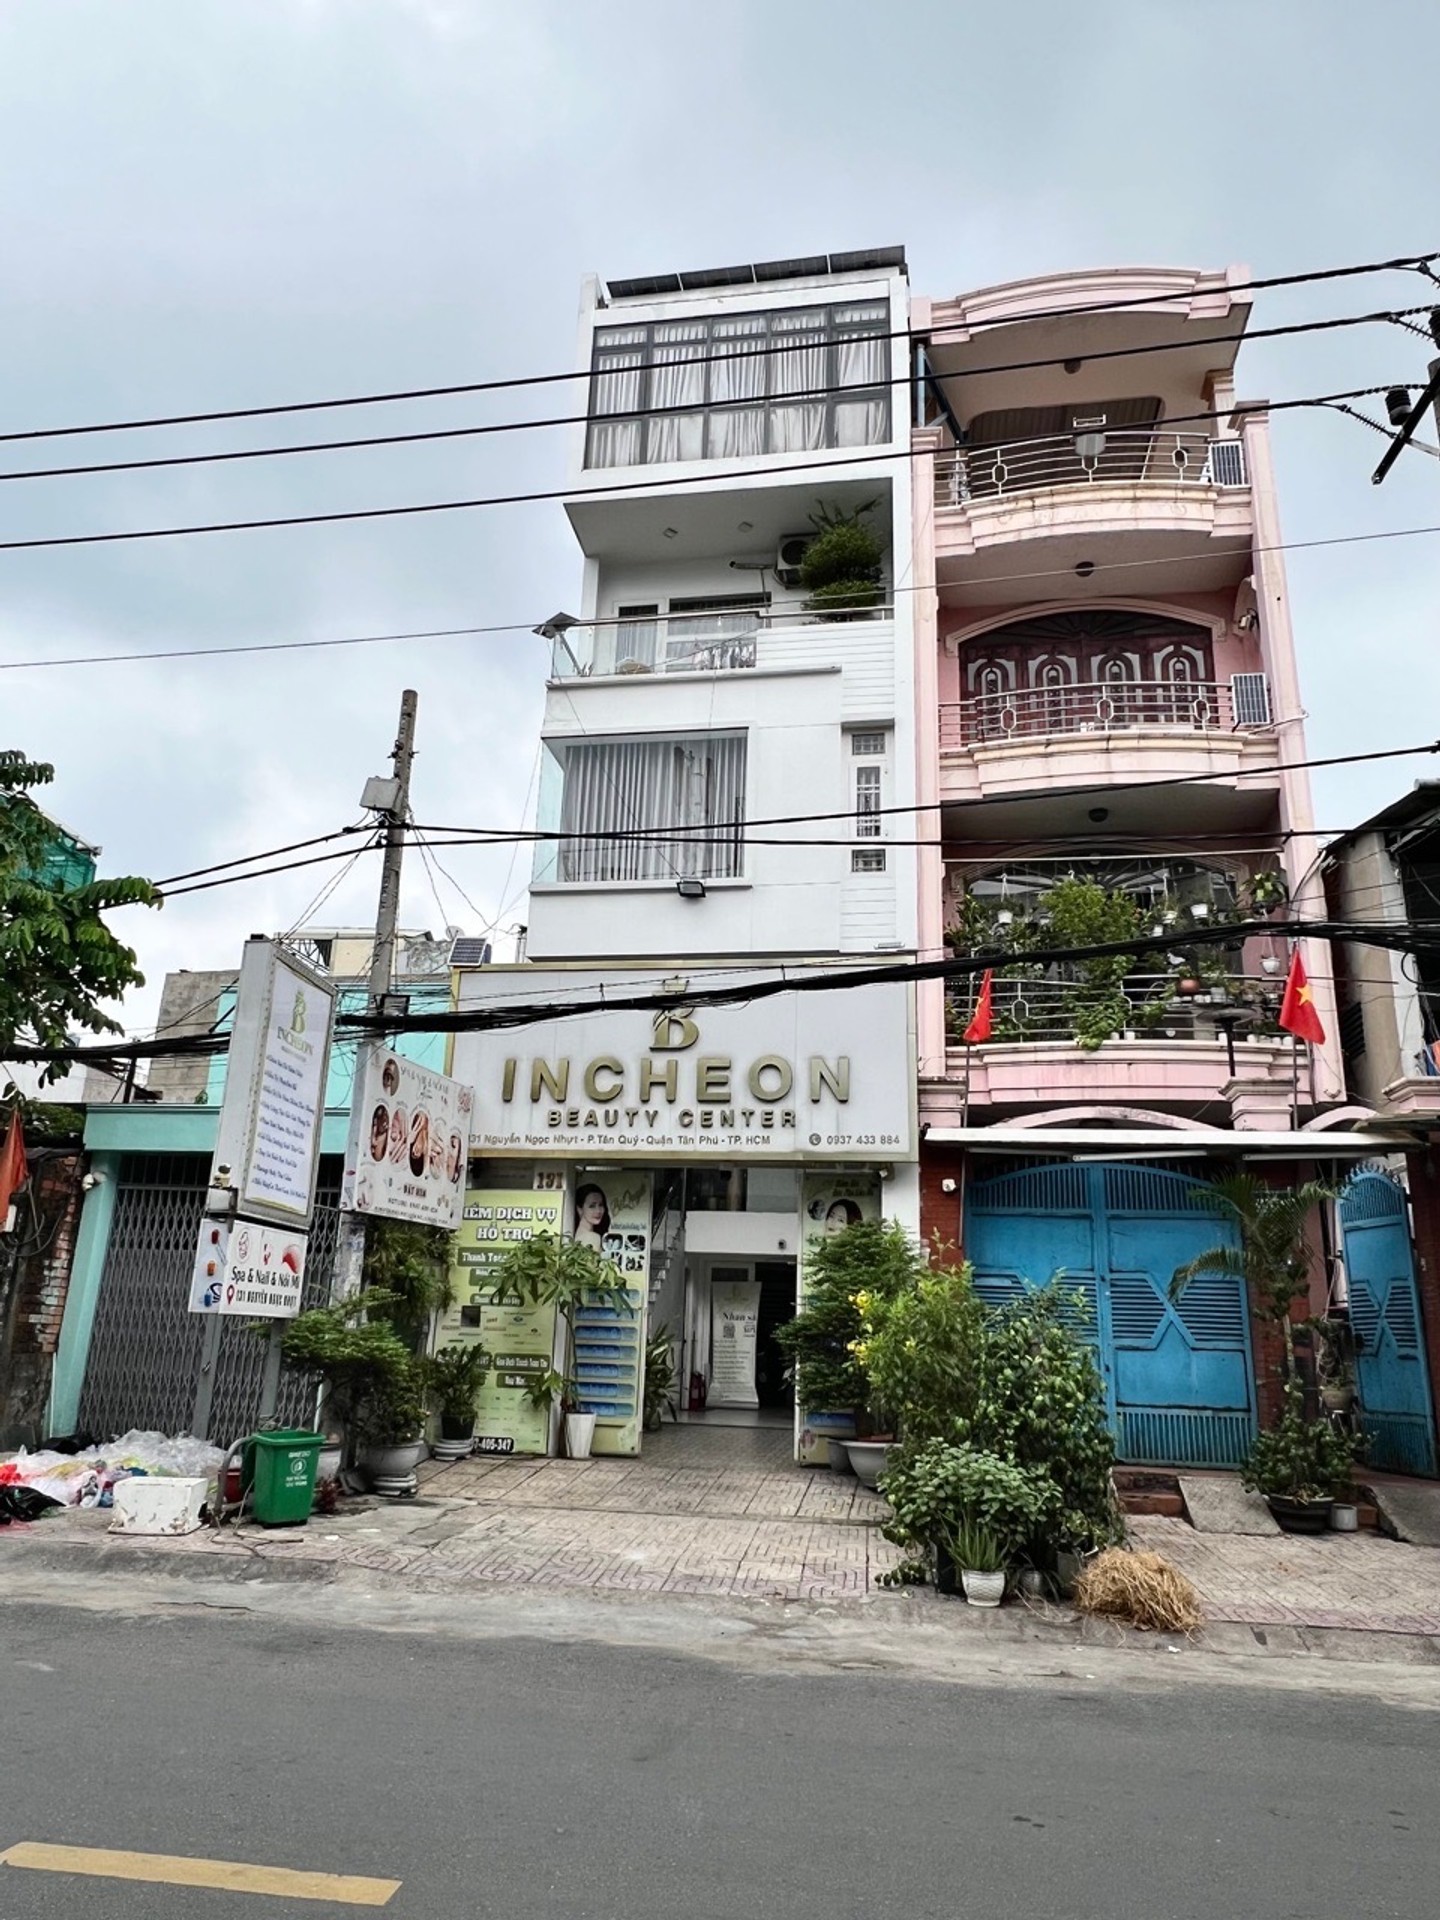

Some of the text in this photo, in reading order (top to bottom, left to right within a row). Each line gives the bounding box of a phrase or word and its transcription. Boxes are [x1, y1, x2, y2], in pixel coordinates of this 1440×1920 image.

[501, 1055, 850, 1103] INCHEON
[547, 1109, 796, 1129] BEAUTY CENTER
[746, 1135, 771, 1145] HCM
[826, 1135, 900, 1145] 0937 433 884
[536, 1171, 564, 1189] 131
[496, 1206, 533, 1224] DỊCH
[535, 1207, 557, 1225] VỤ
[231, 1265, 246, 1285] Spa
[247, 1267, 254, 1283] &
[255, 1269, 270, 1285] Nail
[270, 1271, 277, 1286] &
